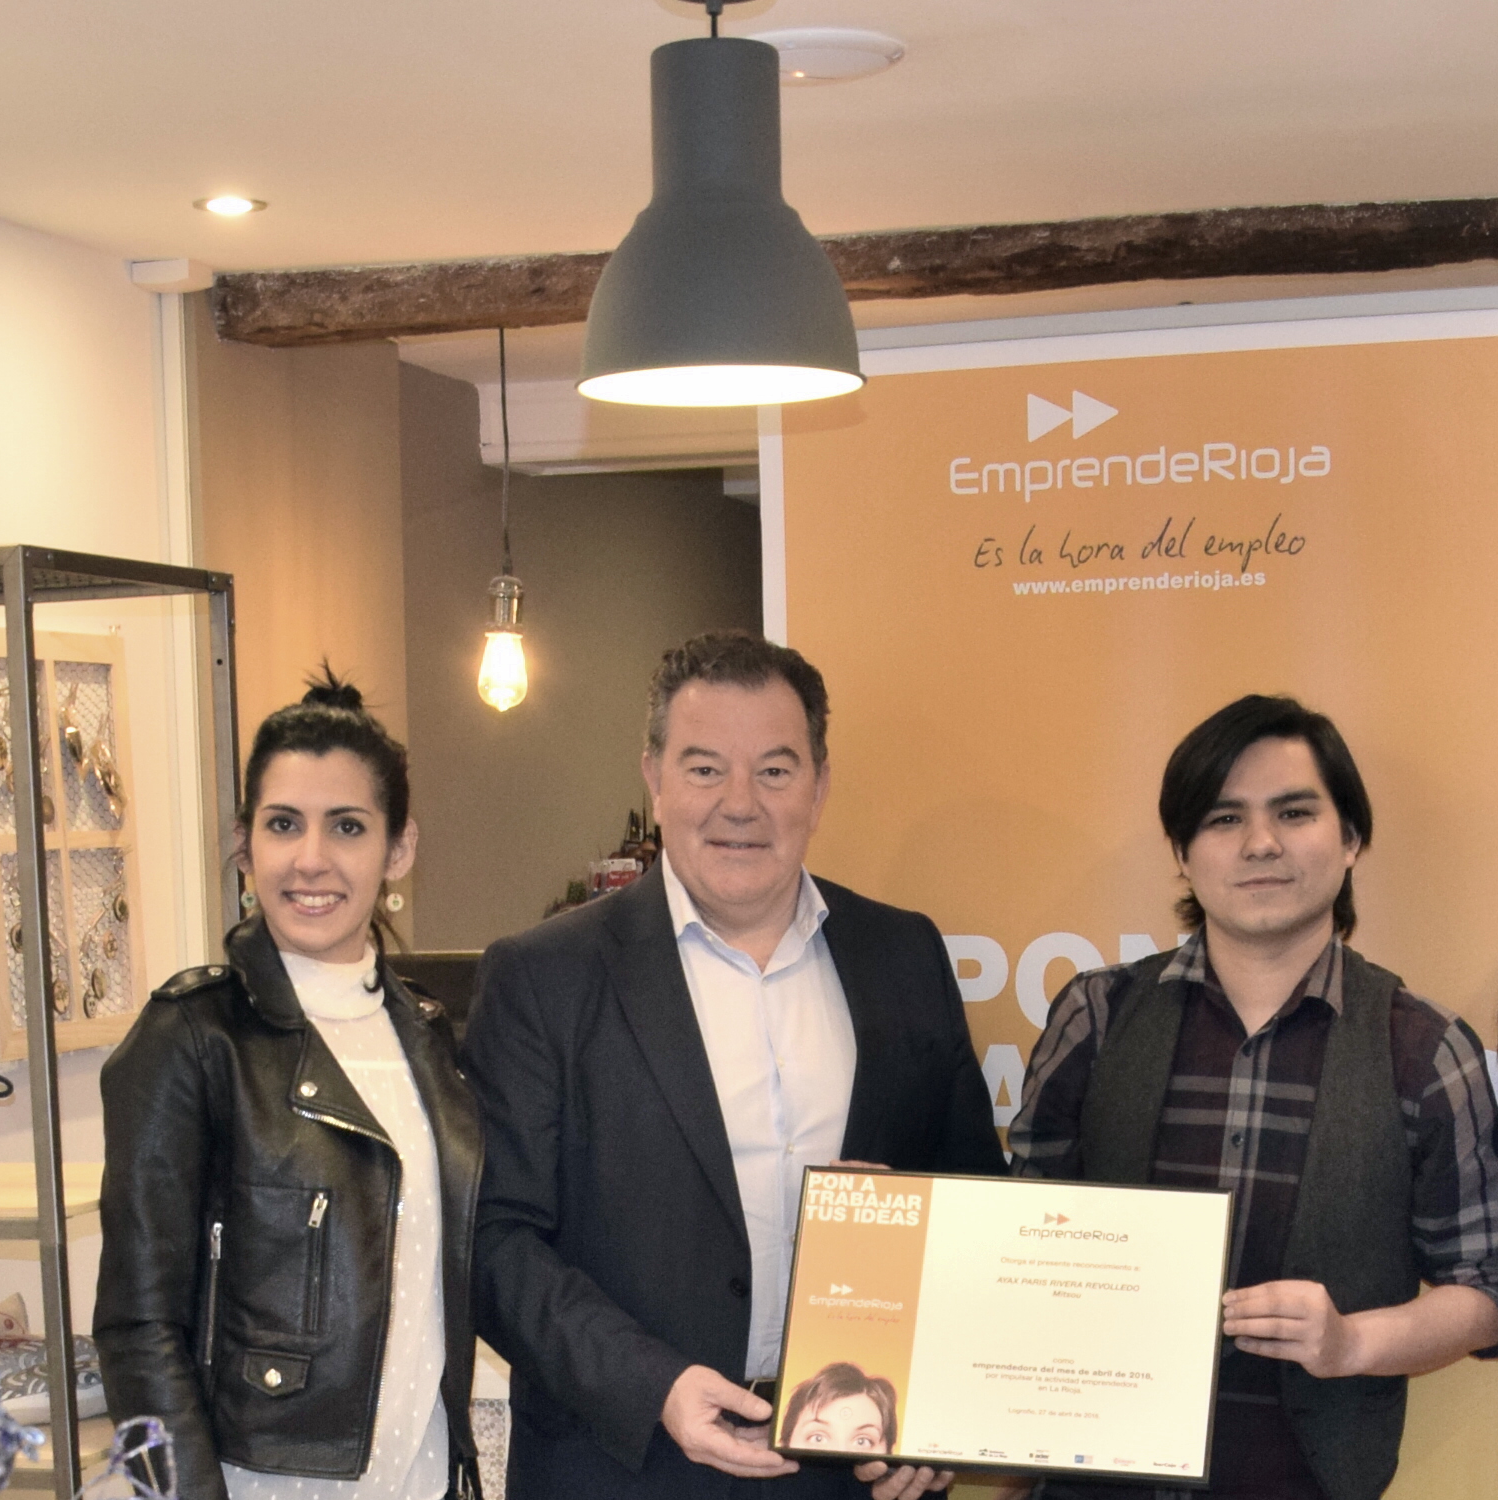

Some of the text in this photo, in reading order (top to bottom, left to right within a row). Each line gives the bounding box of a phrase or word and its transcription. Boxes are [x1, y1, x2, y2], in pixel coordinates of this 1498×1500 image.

[949, 441, 1331, 503] EmprendeRioja
[973, 512, 1307, 574] Es la hora del empleo
[1012, 570, 1266, 596] www.emprenderioja.es
[808, 1173, 875, 1192] PON A
[807, 1189, 922, 1211] TRABAJAR
[805, 1205, 920, 1226] TUS IDEAS
[1018, 1225, 1129, 1243] EmprendeRioja
[1000, 1256, 1027, 1266] Otorga
[1037, 1259, 1071, 1268] presente
[1073, 1262, 1132, 1271] reconocimiento
[996, 1276, 1141, 1292] AYAX PARIS RIVERA REVOLLEDO
[809, 1294, 904, 1311] EmprendeRioja
[1052, 1290, 1082, 1299] Mitsou
[972, 1362, 1038, 1373] emprendedora
[1078, 1368, 1090, 1376] de
[1052, 1357, 1075, 1365] como
[1000, 1373, 1033, 1383] impulsar
[1044, 1376, 1080, 1385] actividad
[1081, 1378, 1138, 1388] emprendedora
[1049, 1385, 1059, 1393] La
